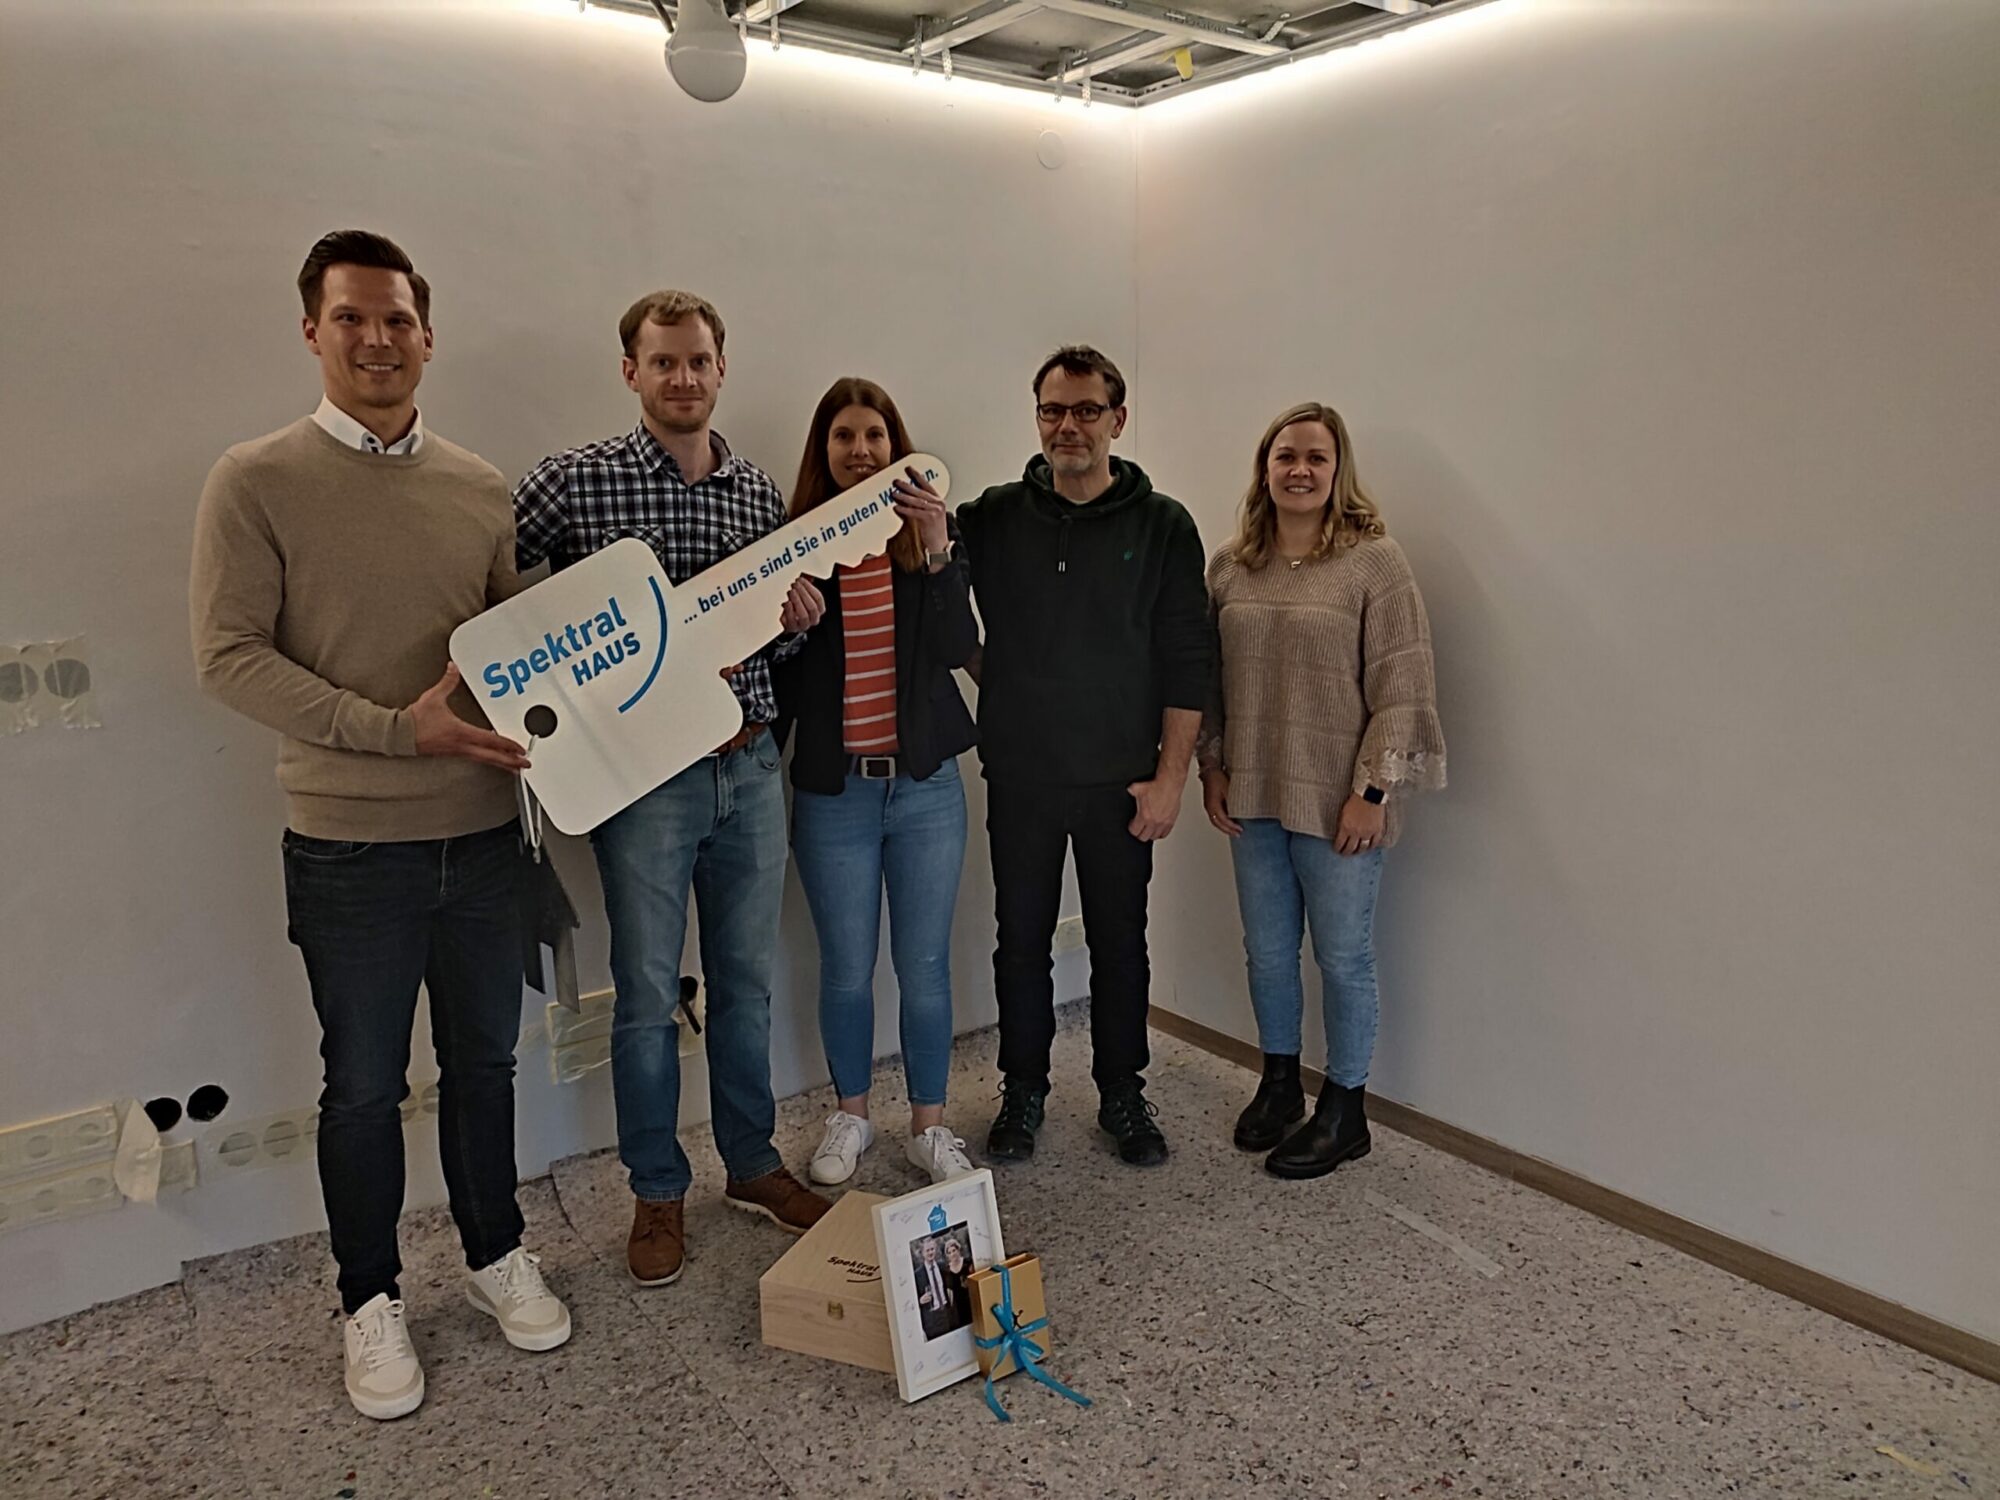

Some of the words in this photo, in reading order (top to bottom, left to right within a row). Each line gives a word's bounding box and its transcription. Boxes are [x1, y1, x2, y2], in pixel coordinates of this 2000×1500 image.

[698, 586, 726, 614] bei
[727, 573, 758, 597] uns
[759, 547, 794, 578] sind
[794, 536, 820, 558] Sie
[820, 527, 837, 543] in
[838, 501, 880, 536] guten
[483, 596, 628, 699] Spektral
[571, 632, 641, 687] HAUS
[827, 1256, 880, 1271] Spektral
